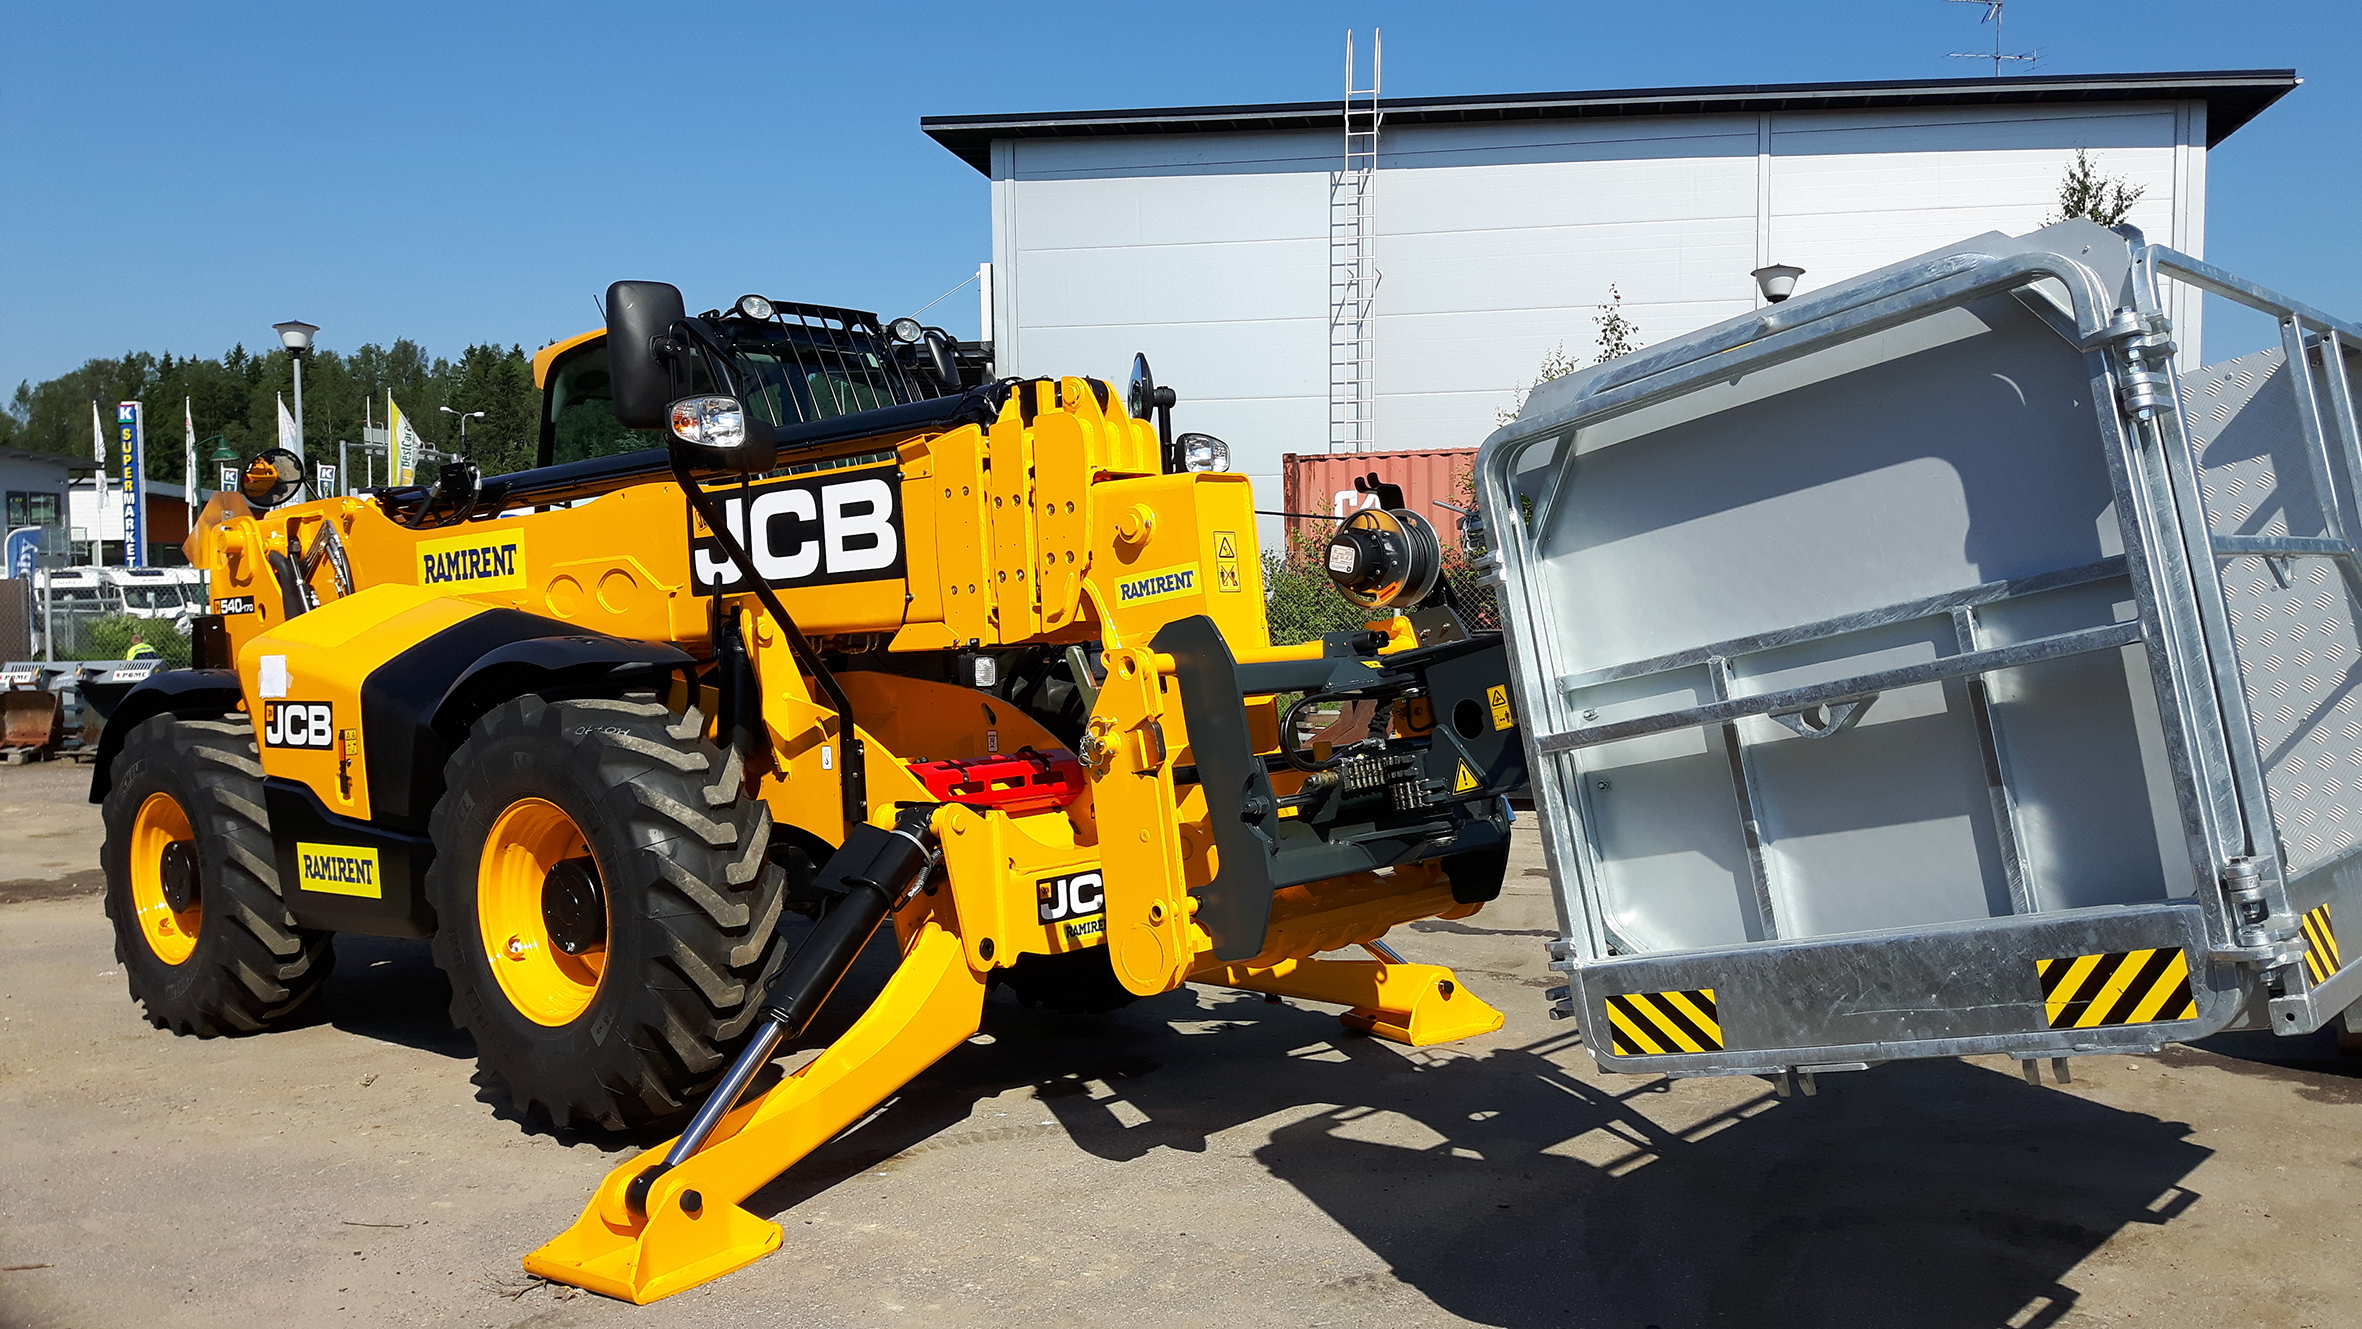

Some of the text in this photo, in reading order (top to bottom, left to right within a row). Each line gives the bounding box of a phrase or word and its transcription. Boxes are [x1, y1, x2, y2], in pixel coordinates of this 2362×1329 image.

[120, 407, 132, 420] K
[401, 424, 412, 468] BestCara
[122, 428, 136, 568] SUPERMARKET
[694, 478, 898, 586] JCB
[423, 543, 517, 584] RAMIRENT
[1120, 570, 1194, 602] RAMIRENT
[266, 704, 333, 746] JCB
[303, 854, 373, 885] RAMIRENT
[1040, 873, 1104, 920] JC
